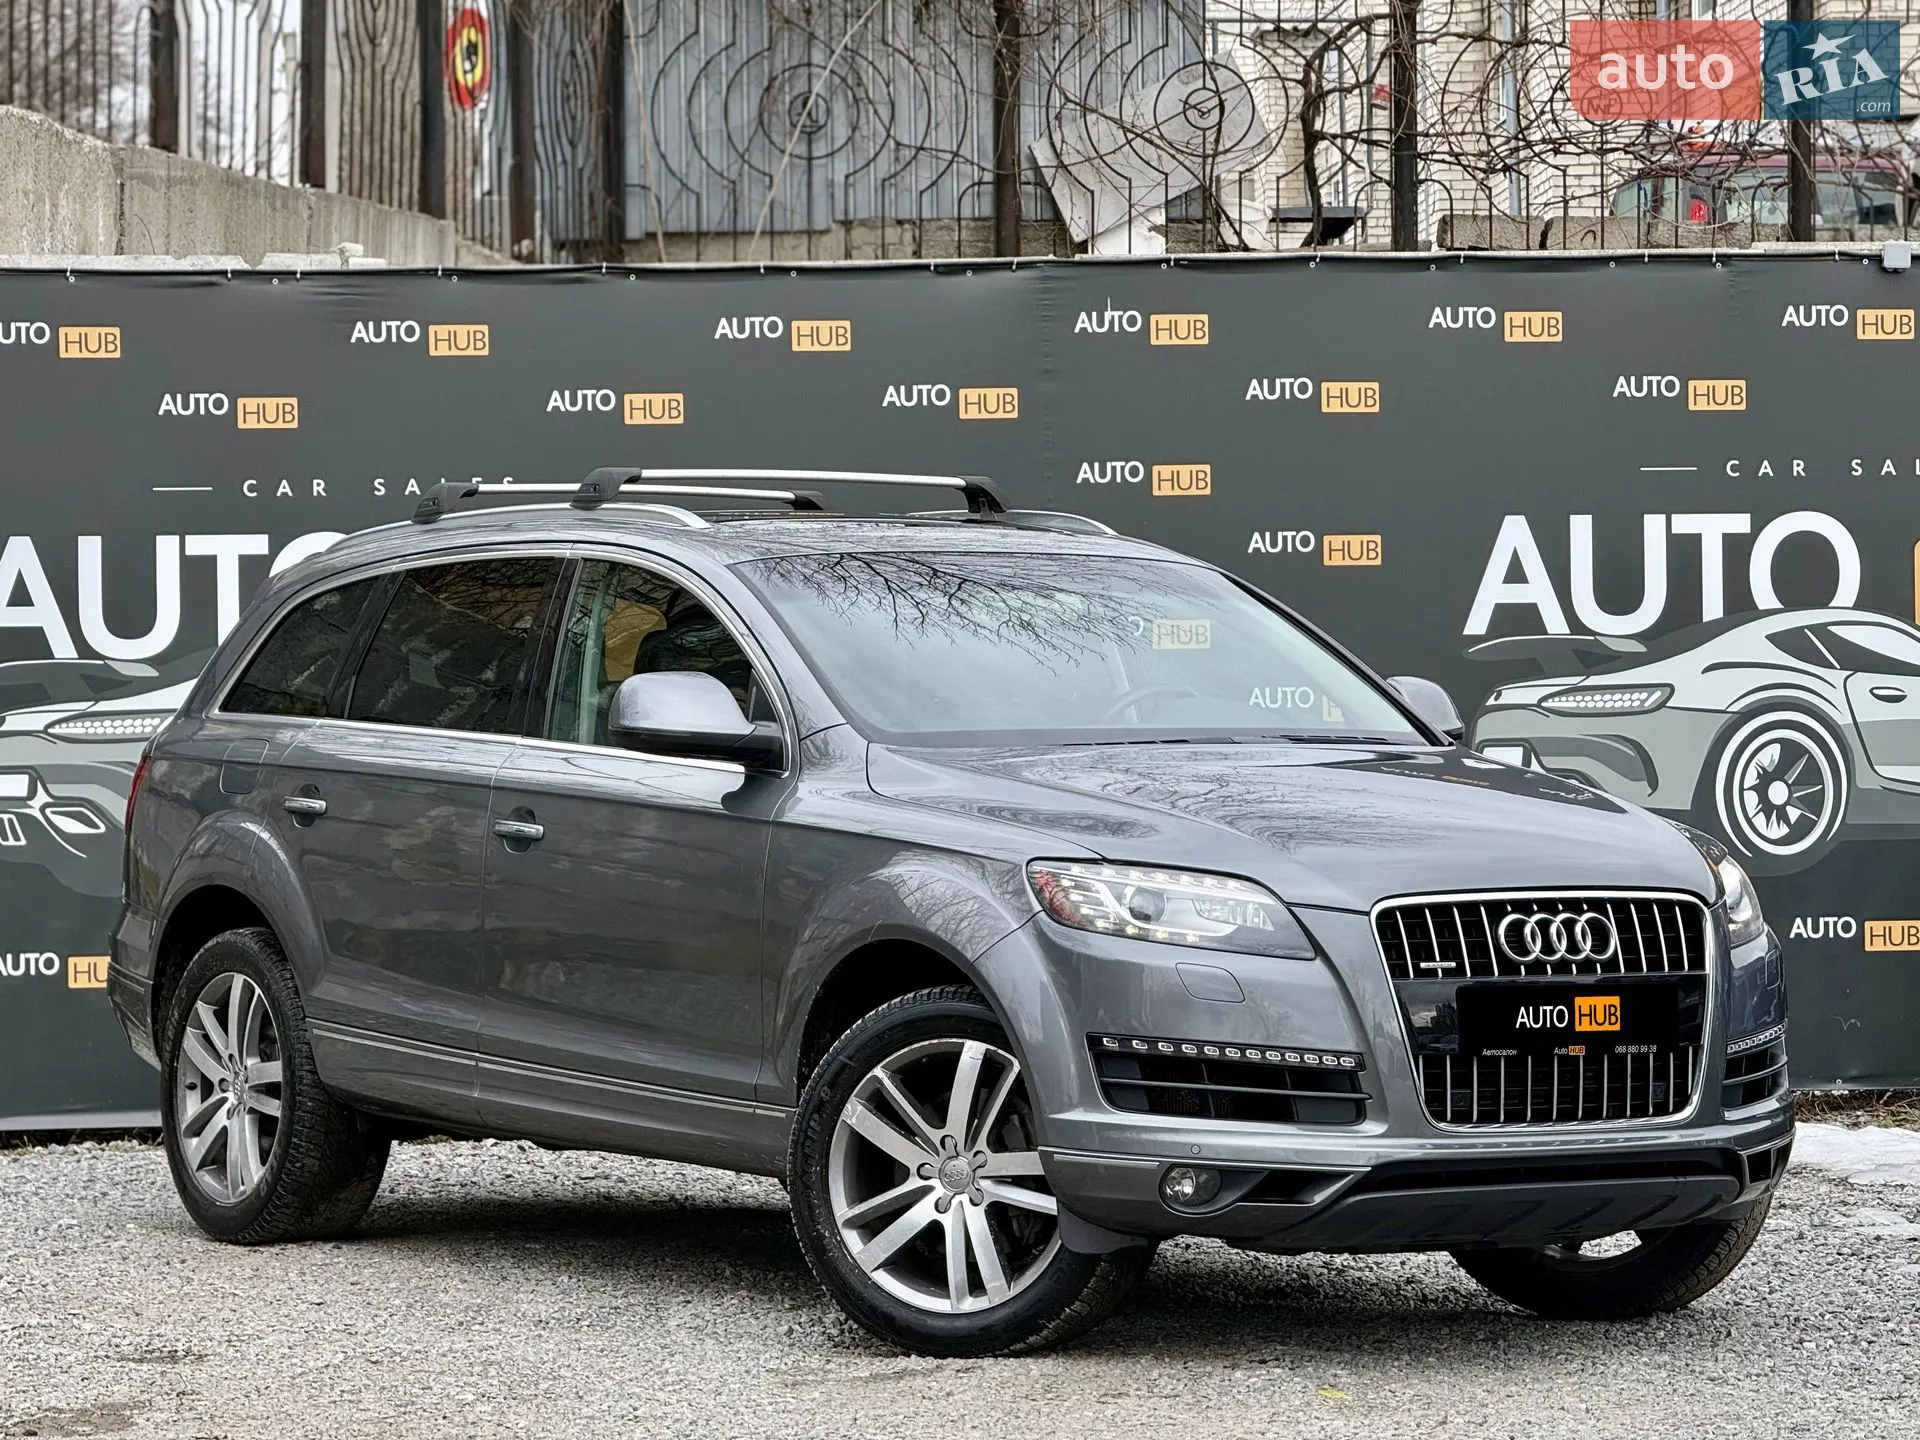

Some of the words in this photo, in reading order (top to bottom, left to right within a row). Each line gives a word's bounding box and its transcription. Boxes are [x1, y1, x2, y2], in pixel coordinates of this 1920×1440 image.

[350, 320, 421, 344] AUTO
[432, 329, 489, 352] HUB
[714, 315, 784, 340] AUTO
[795, 324, 851, 348] HUB
[1074, 308, 1143, 334] AUTO
[1154, 318, 1208, 342] HUB
[1428, 306, 1497, 329] AUTO
[1508, 316, 1561, 338] HUB
[1781, 304, 1849, 327] AUTO
[1860, 314, 1913, 336] HUB
[0, 321, 51, 345] UTO
[63, 331, 121, 354] HUB
[546, 388, 616, 412] AUTO
[628, 397, 683, 421] HUB
[882, 383, 951, 407] AUTO
[963, 392, 1017, 416] HUB
[1245, 377, 1314, 401] AUTO
[1325, 386, 1378, 409] HUB
[1612, 375, 1681, 398] AUTO
[1692, 384, 1745, 408] HUB
[157, 392, 229, 416] AUTO
[241, 401, 298, 425] HUB
[1076, 460, 1145, 484] AUTO
[1156, 469, 1208, 492] HUB
[1725, 459, 1806, 477] CAR
[242, 478, 328, 497] CAR
[1247, 530, 1316, 554] AUTO
[1327, 539, 1381, 562] HUB
[1463, 511, 1861, 636] AUTO
[0, 531, 352, 660] AUT
[1249, 686, 1315, 709] AUTO
[1789, 916, 1857, 939] AUTO
[1868, 925, 1920, 948] HUB
[72, 961, 107, 984] HU
[1516, 1005, 1569, 1028] AUTO
[1578, 1003, 1620, 1027] HUB
[1553, 1046, 1568, 1055] Auto
[1568, 1045, 1585, 1055] HUB
